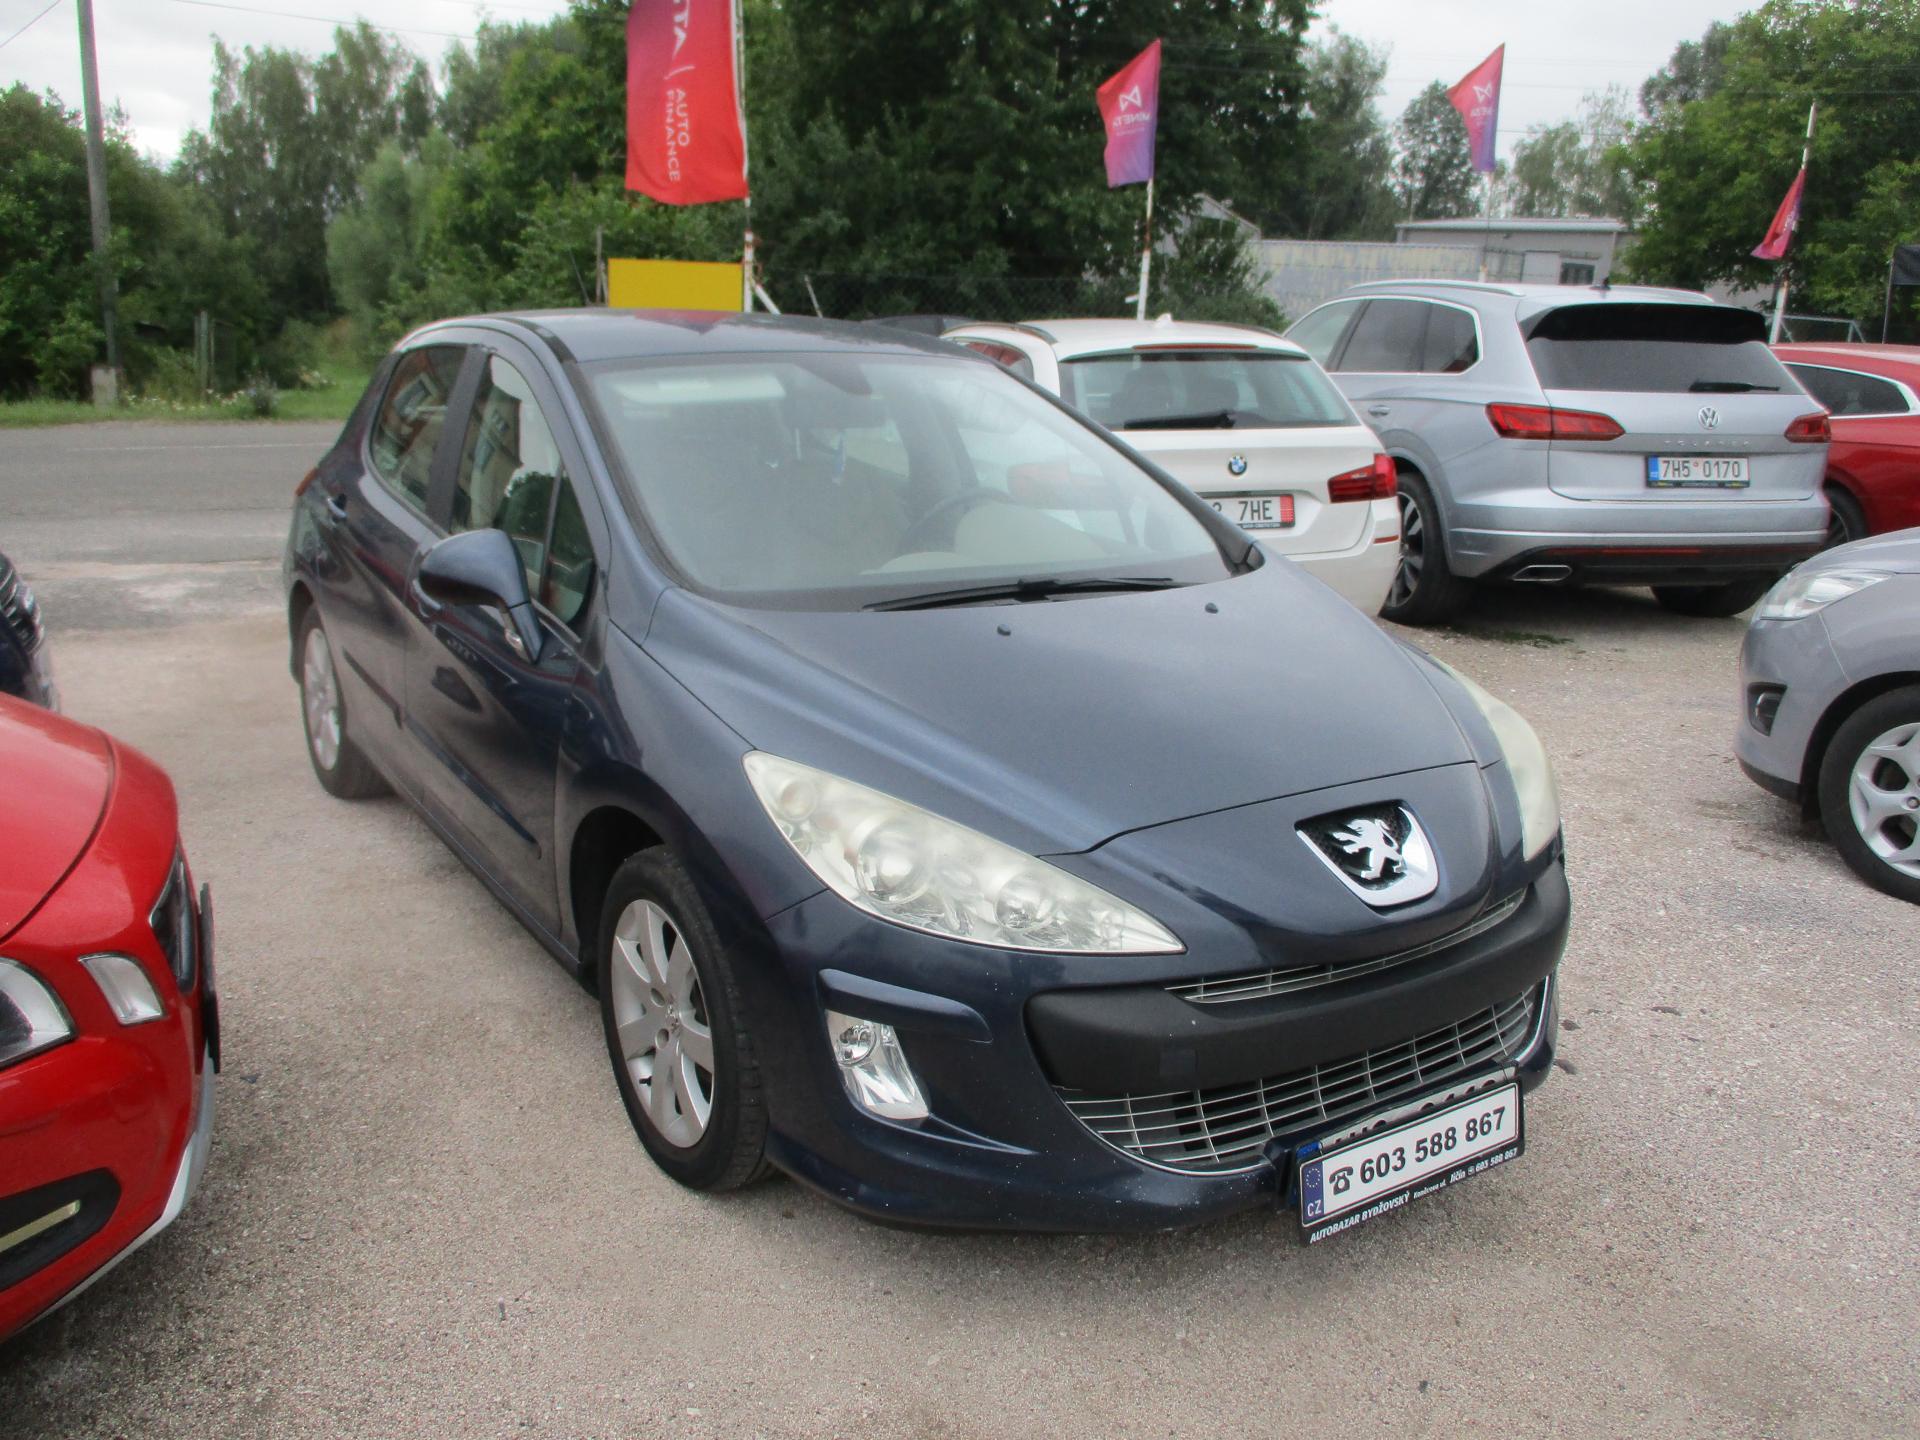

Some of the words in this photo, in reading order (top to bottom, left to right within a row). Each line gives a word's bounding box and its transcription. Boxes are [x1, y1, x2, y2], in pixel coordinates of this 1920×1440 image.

[672, 0, 690, 60] TA
[666, 89, 680, 181] FINANCE
[676, 88, 690, 147] AUTO
[1662, 460, 1690, 478] 7H5
[1703, 460, 1740, 478] 0170
[1238, 500, 1272, 521] 7HE
[1360, 1147, 1405, 1184] 603
[1415, 1127, 1457, 1163] 588
[1465, 1106, 1505, 1143] 867
[1307, 1200, 1322, 1217] CZ
[1310, 1214, 1360, 1244] AUTOBAZAR
[1361, 1191, 1410, 1221] BYDŽOVSKÝ
[1476, 1159, 1489, 1172] 603
